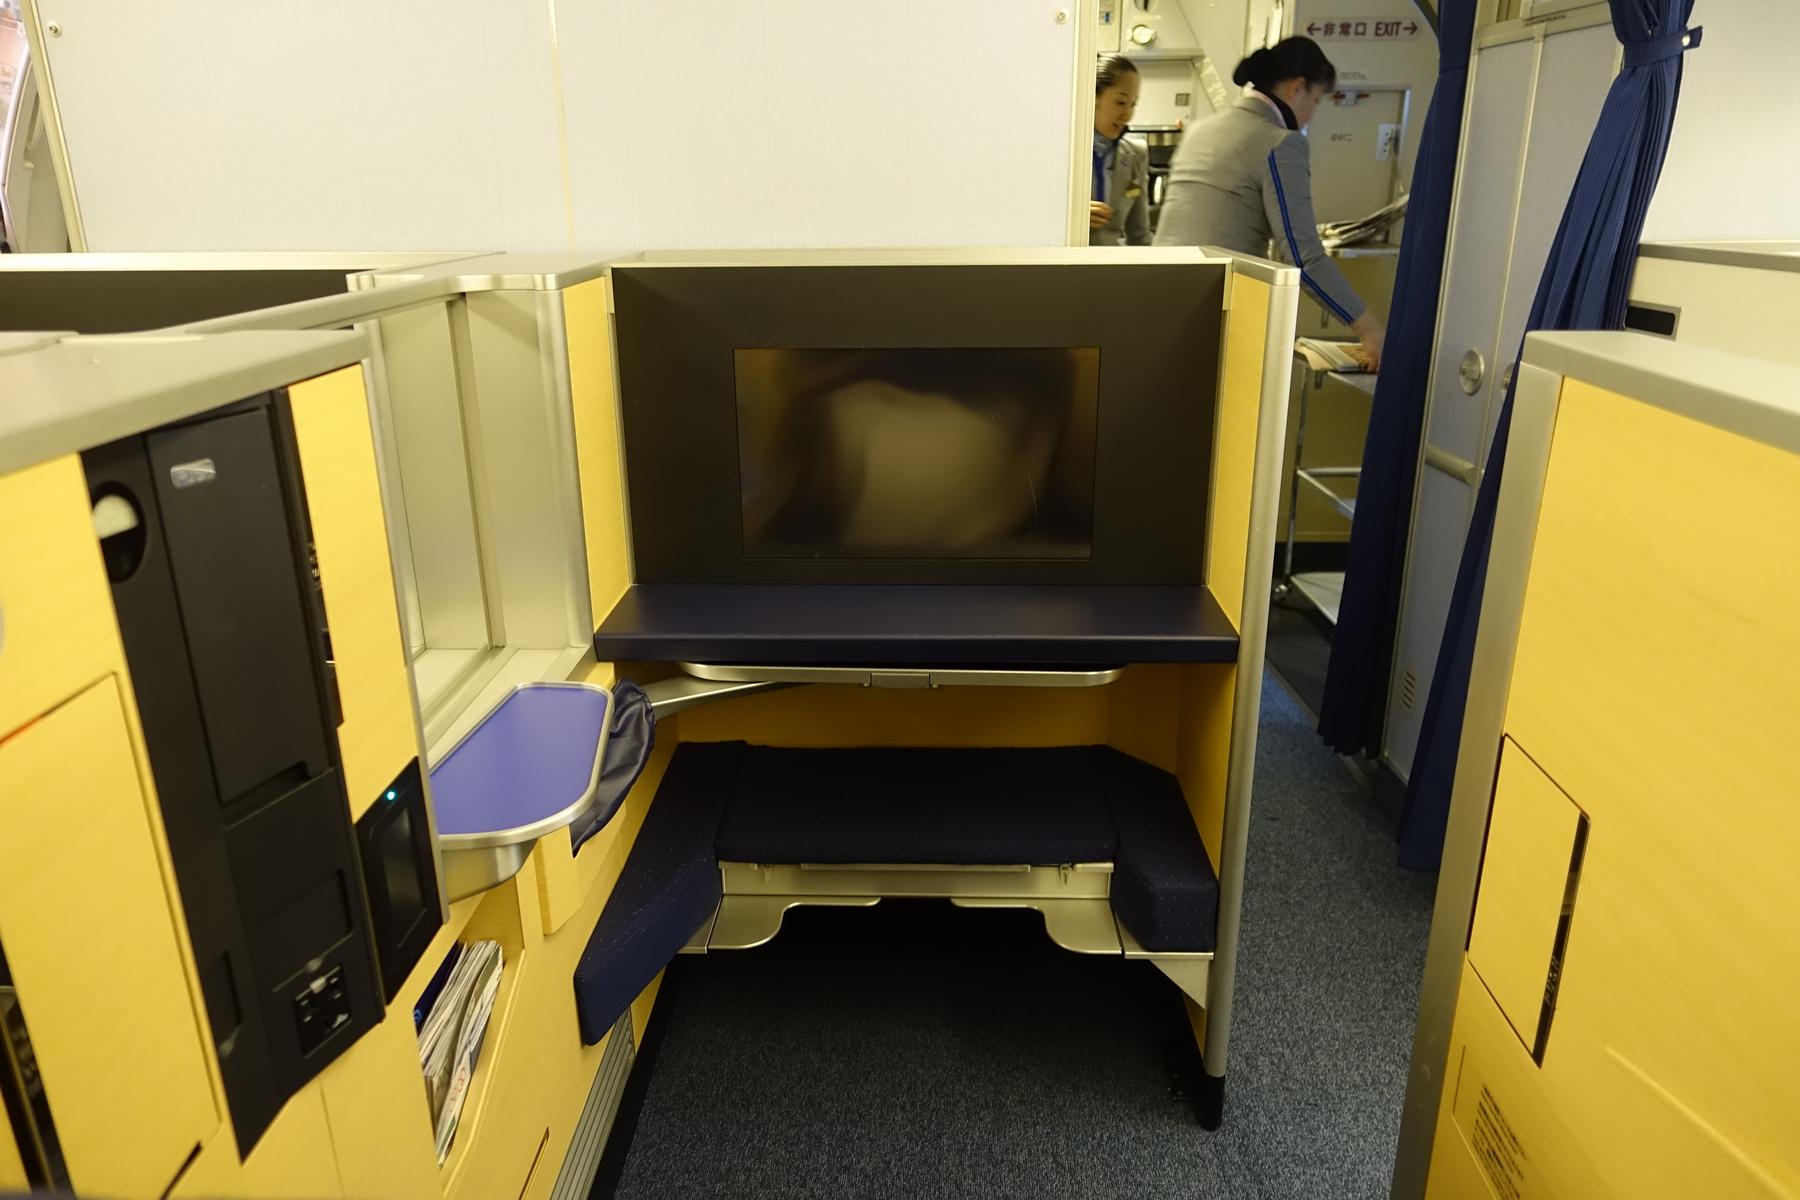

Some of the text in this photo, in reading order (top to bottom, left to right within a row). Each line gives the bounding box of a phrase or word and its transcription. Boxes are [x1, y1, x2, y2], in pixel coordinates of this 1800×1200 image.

[1323, 21, 1402, 36] 非常口 EXIT
